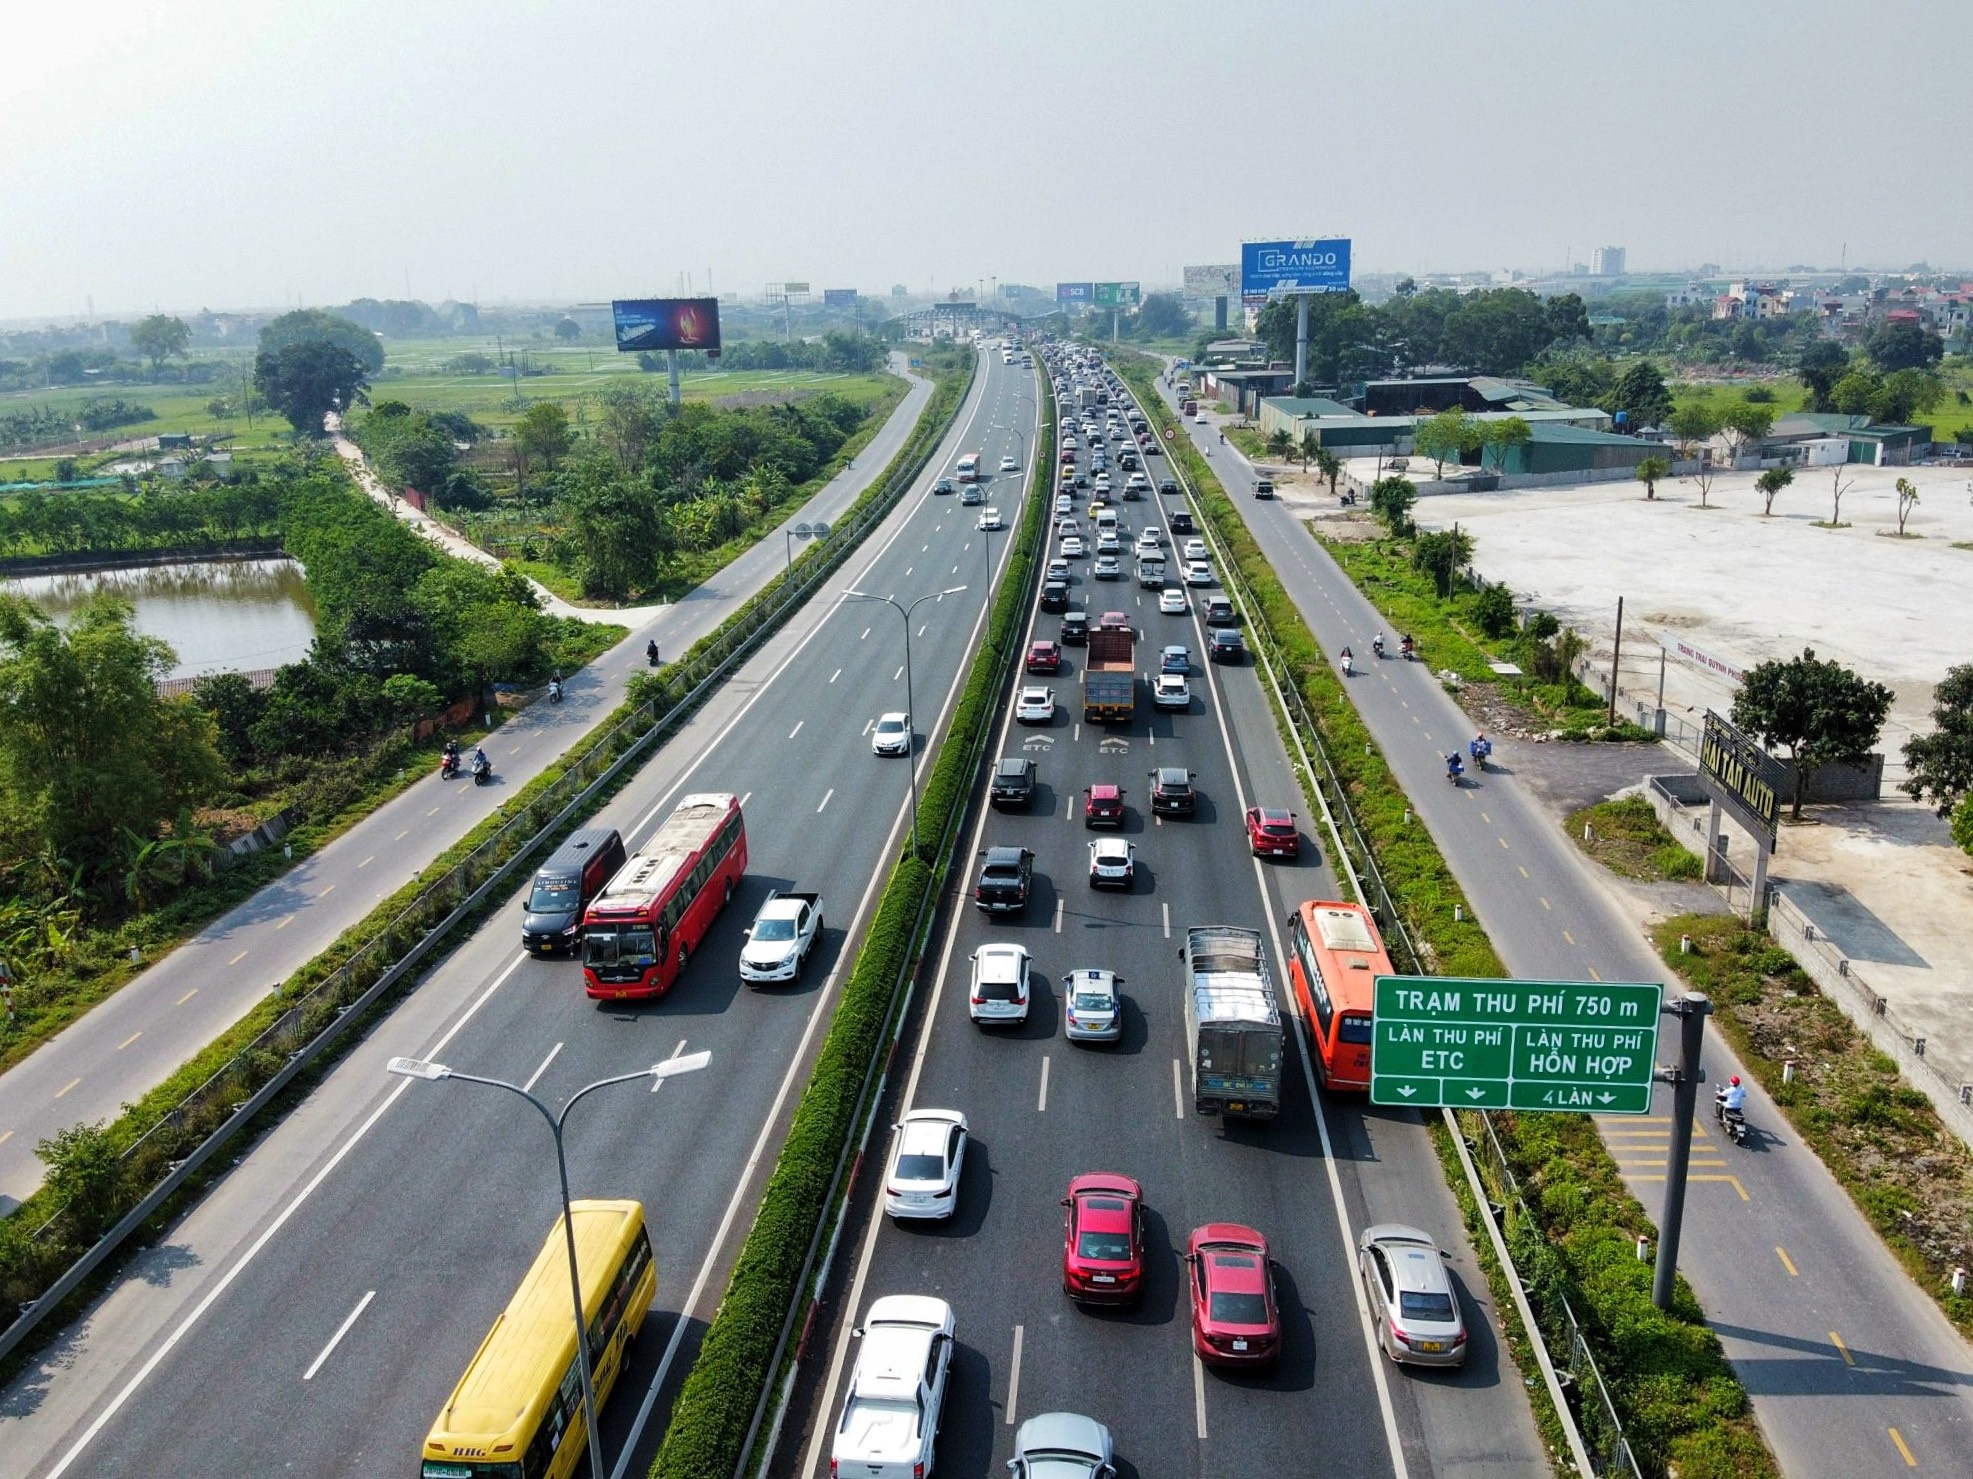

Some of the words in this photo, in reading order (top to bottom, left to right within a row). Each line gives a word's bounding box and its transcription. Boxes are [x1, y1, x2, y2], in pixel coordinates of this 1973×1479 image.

[1265, 253, 1336, 267] GRANDO
[1743, 772, 1775, 820] AUTO
[1395, 990, 1461, 1016] TRẠM
[1472, 993, 1517, 1013] THU
[1527, 990, 1566, 1015] PHÍ
[1575, 996, 1612, 1016] 750
[1619, 1001, 1638, 1016] m
[1388, 1024, 1424, 1043] LÀN
[1433, 1029, 1467, 1044] THU
[1474, 1027, 1503, 1046] PHÍ
[1526, 1028, 1562, 1047] LÀN
[1571, 1033, 1605, 1048] THU
[1613, 1031, 1643, 1050] PHÍ
[1421, 1050, 1464, 1070] ETC
[1529, 1047, 1576, 1074] HỖN
[1585, 1055, 1632, 1080] HỢP
[1542, 1090, 1554, 1105] 4
[1558, 1087, 1593, 1105] LÀN
[453, 1448, 486, 1456] HHG
